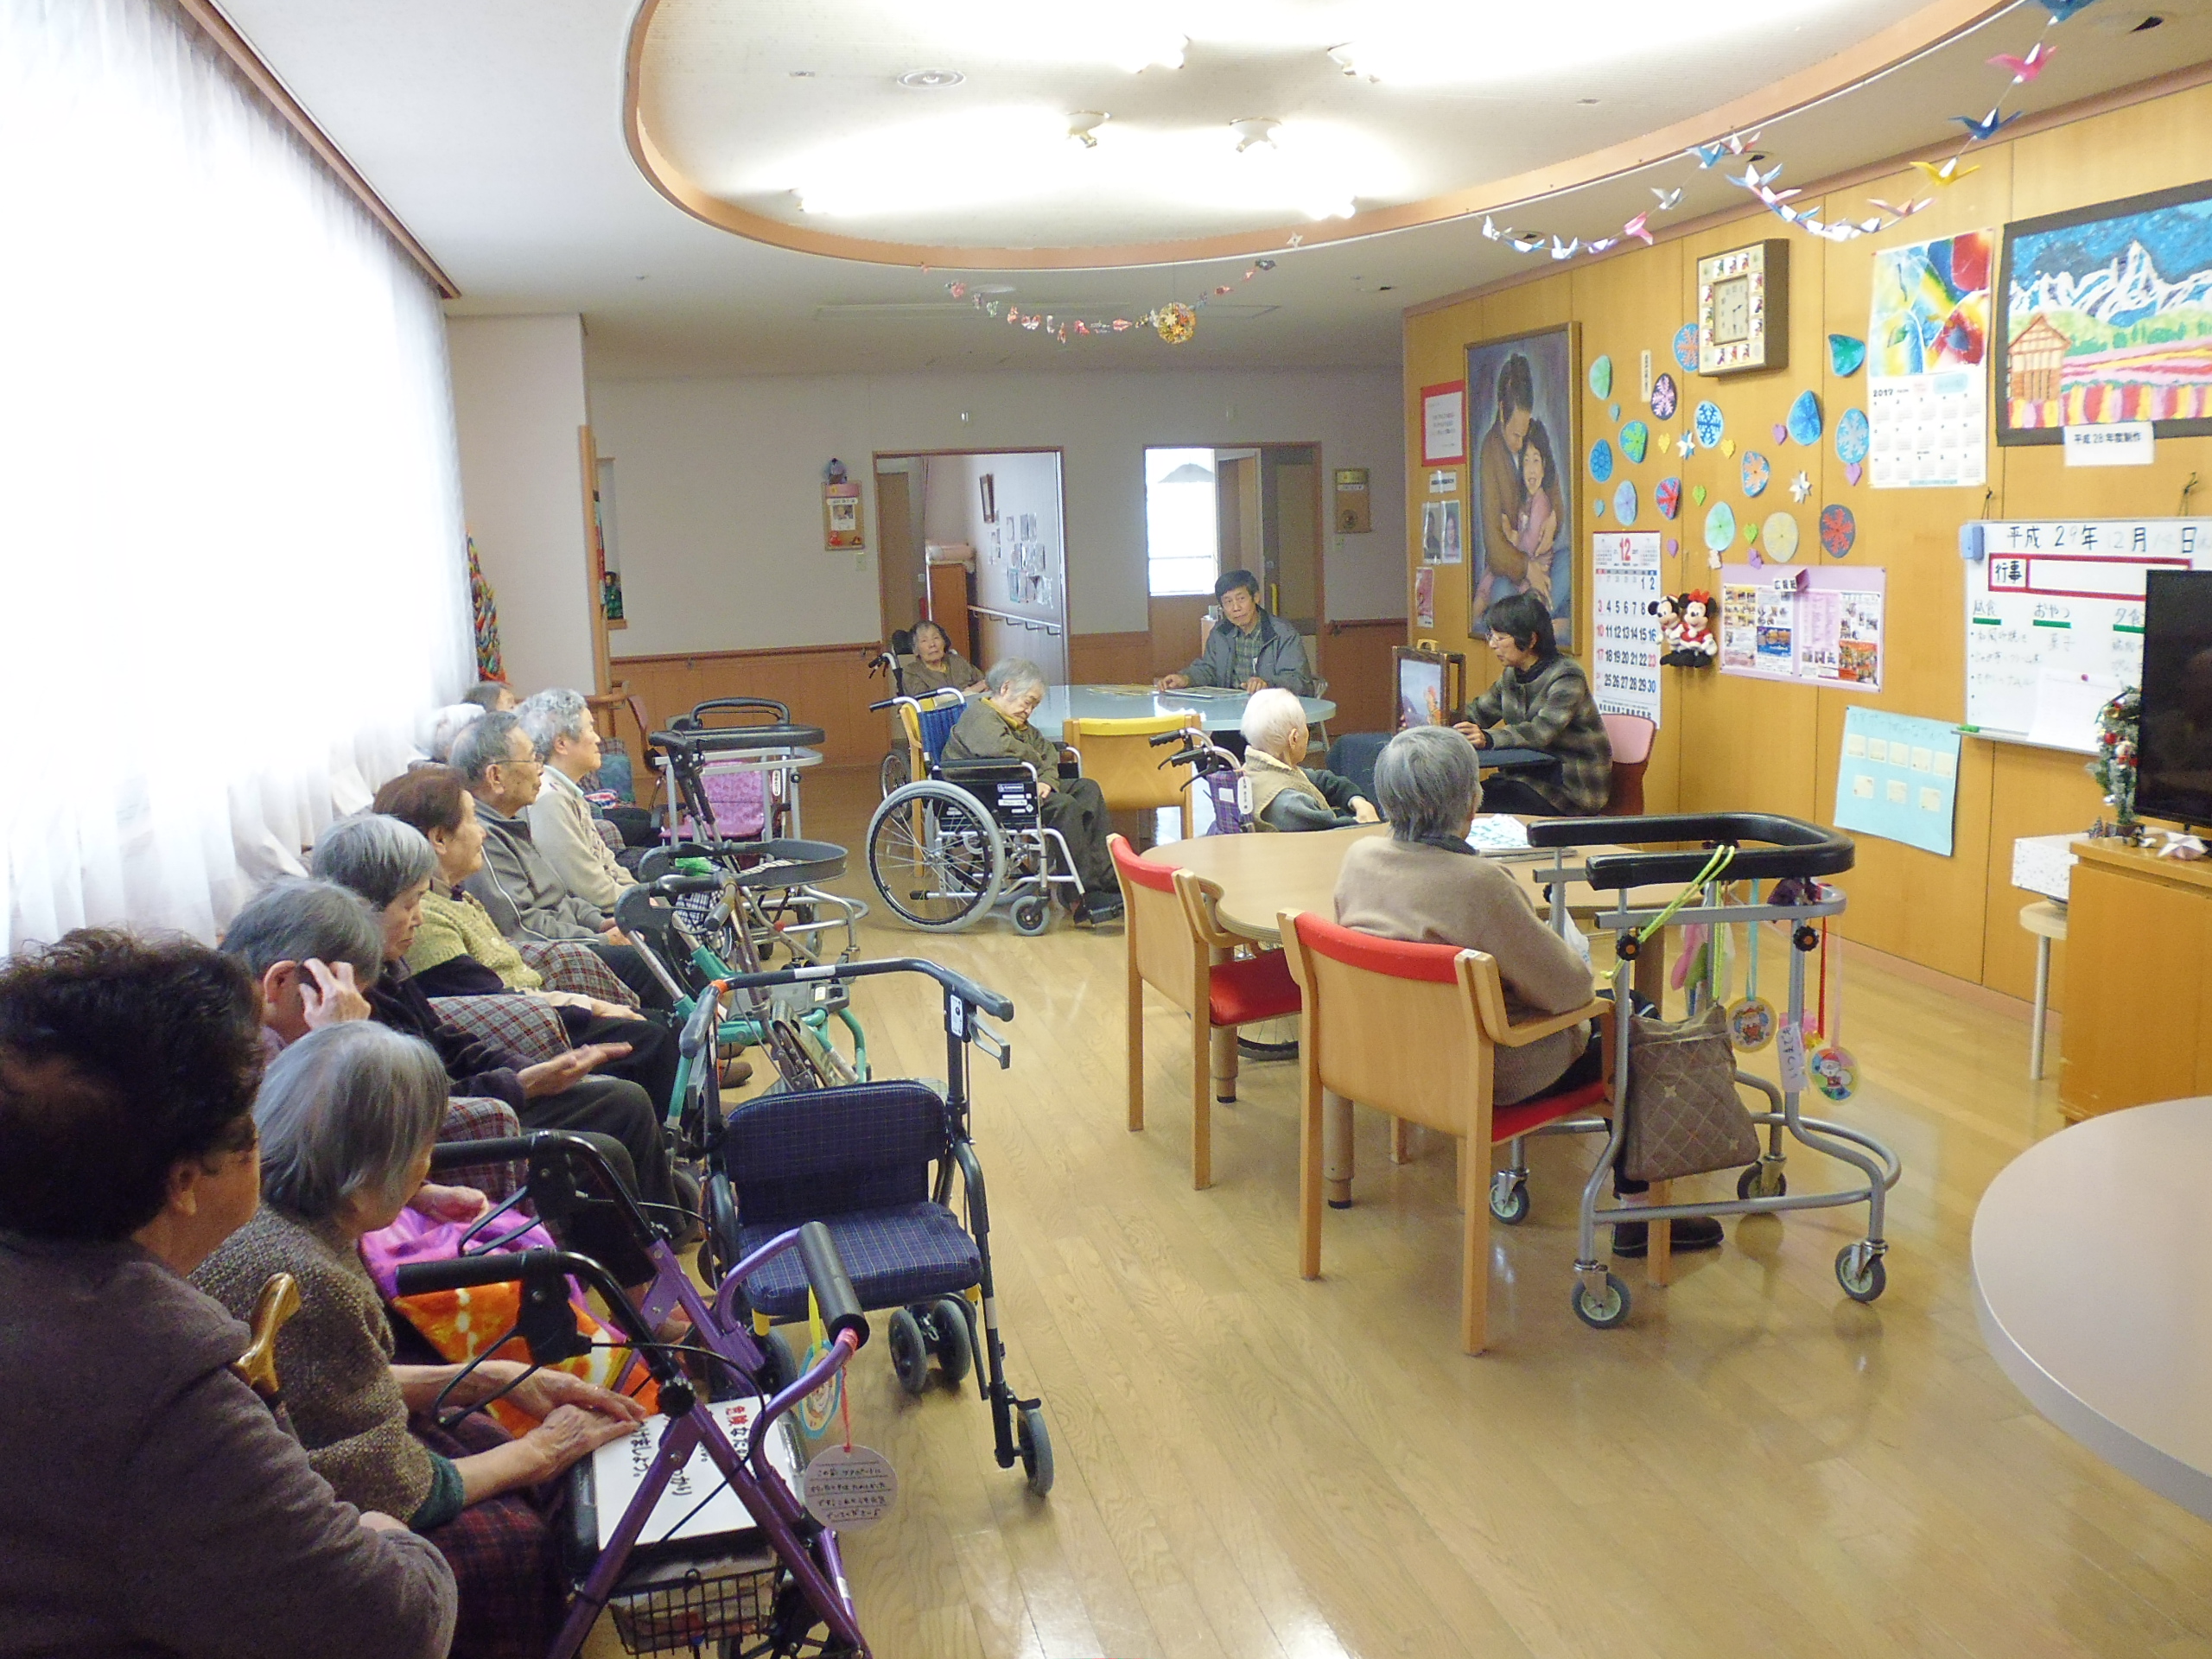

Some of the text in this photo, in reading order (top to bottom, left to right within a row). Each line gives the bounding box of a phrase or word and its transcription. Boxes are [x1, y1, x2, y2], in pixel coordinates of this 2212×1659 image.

[1873, 389, 1893, 397] 2017
[1619, 537, 1630, 561] 12
[1994, 560, 2023, 584] 行事
[1642, 576, 1644, 589] 1
[1649, 576, 1655, 590] 2
[1598, 599, 1646, 615] 3 4 5 6 7 8
[2034, 602, 2071, 619] おやつ
[1597, 624, 1656, 641] 10 11 12 13 14 15 16
[1597, 648, 1656, 668] 17 18 19 20 21 22 23
[1605, 673, 1612, 686] 25
[1612, 675, 1620, 688] 26
[1621, 676, 1628, 690] 27
[1630, 677, 1637, 690] 28
[1638, 677, 1647, 691] 29
[1647, 679, 1656, 693] 30
